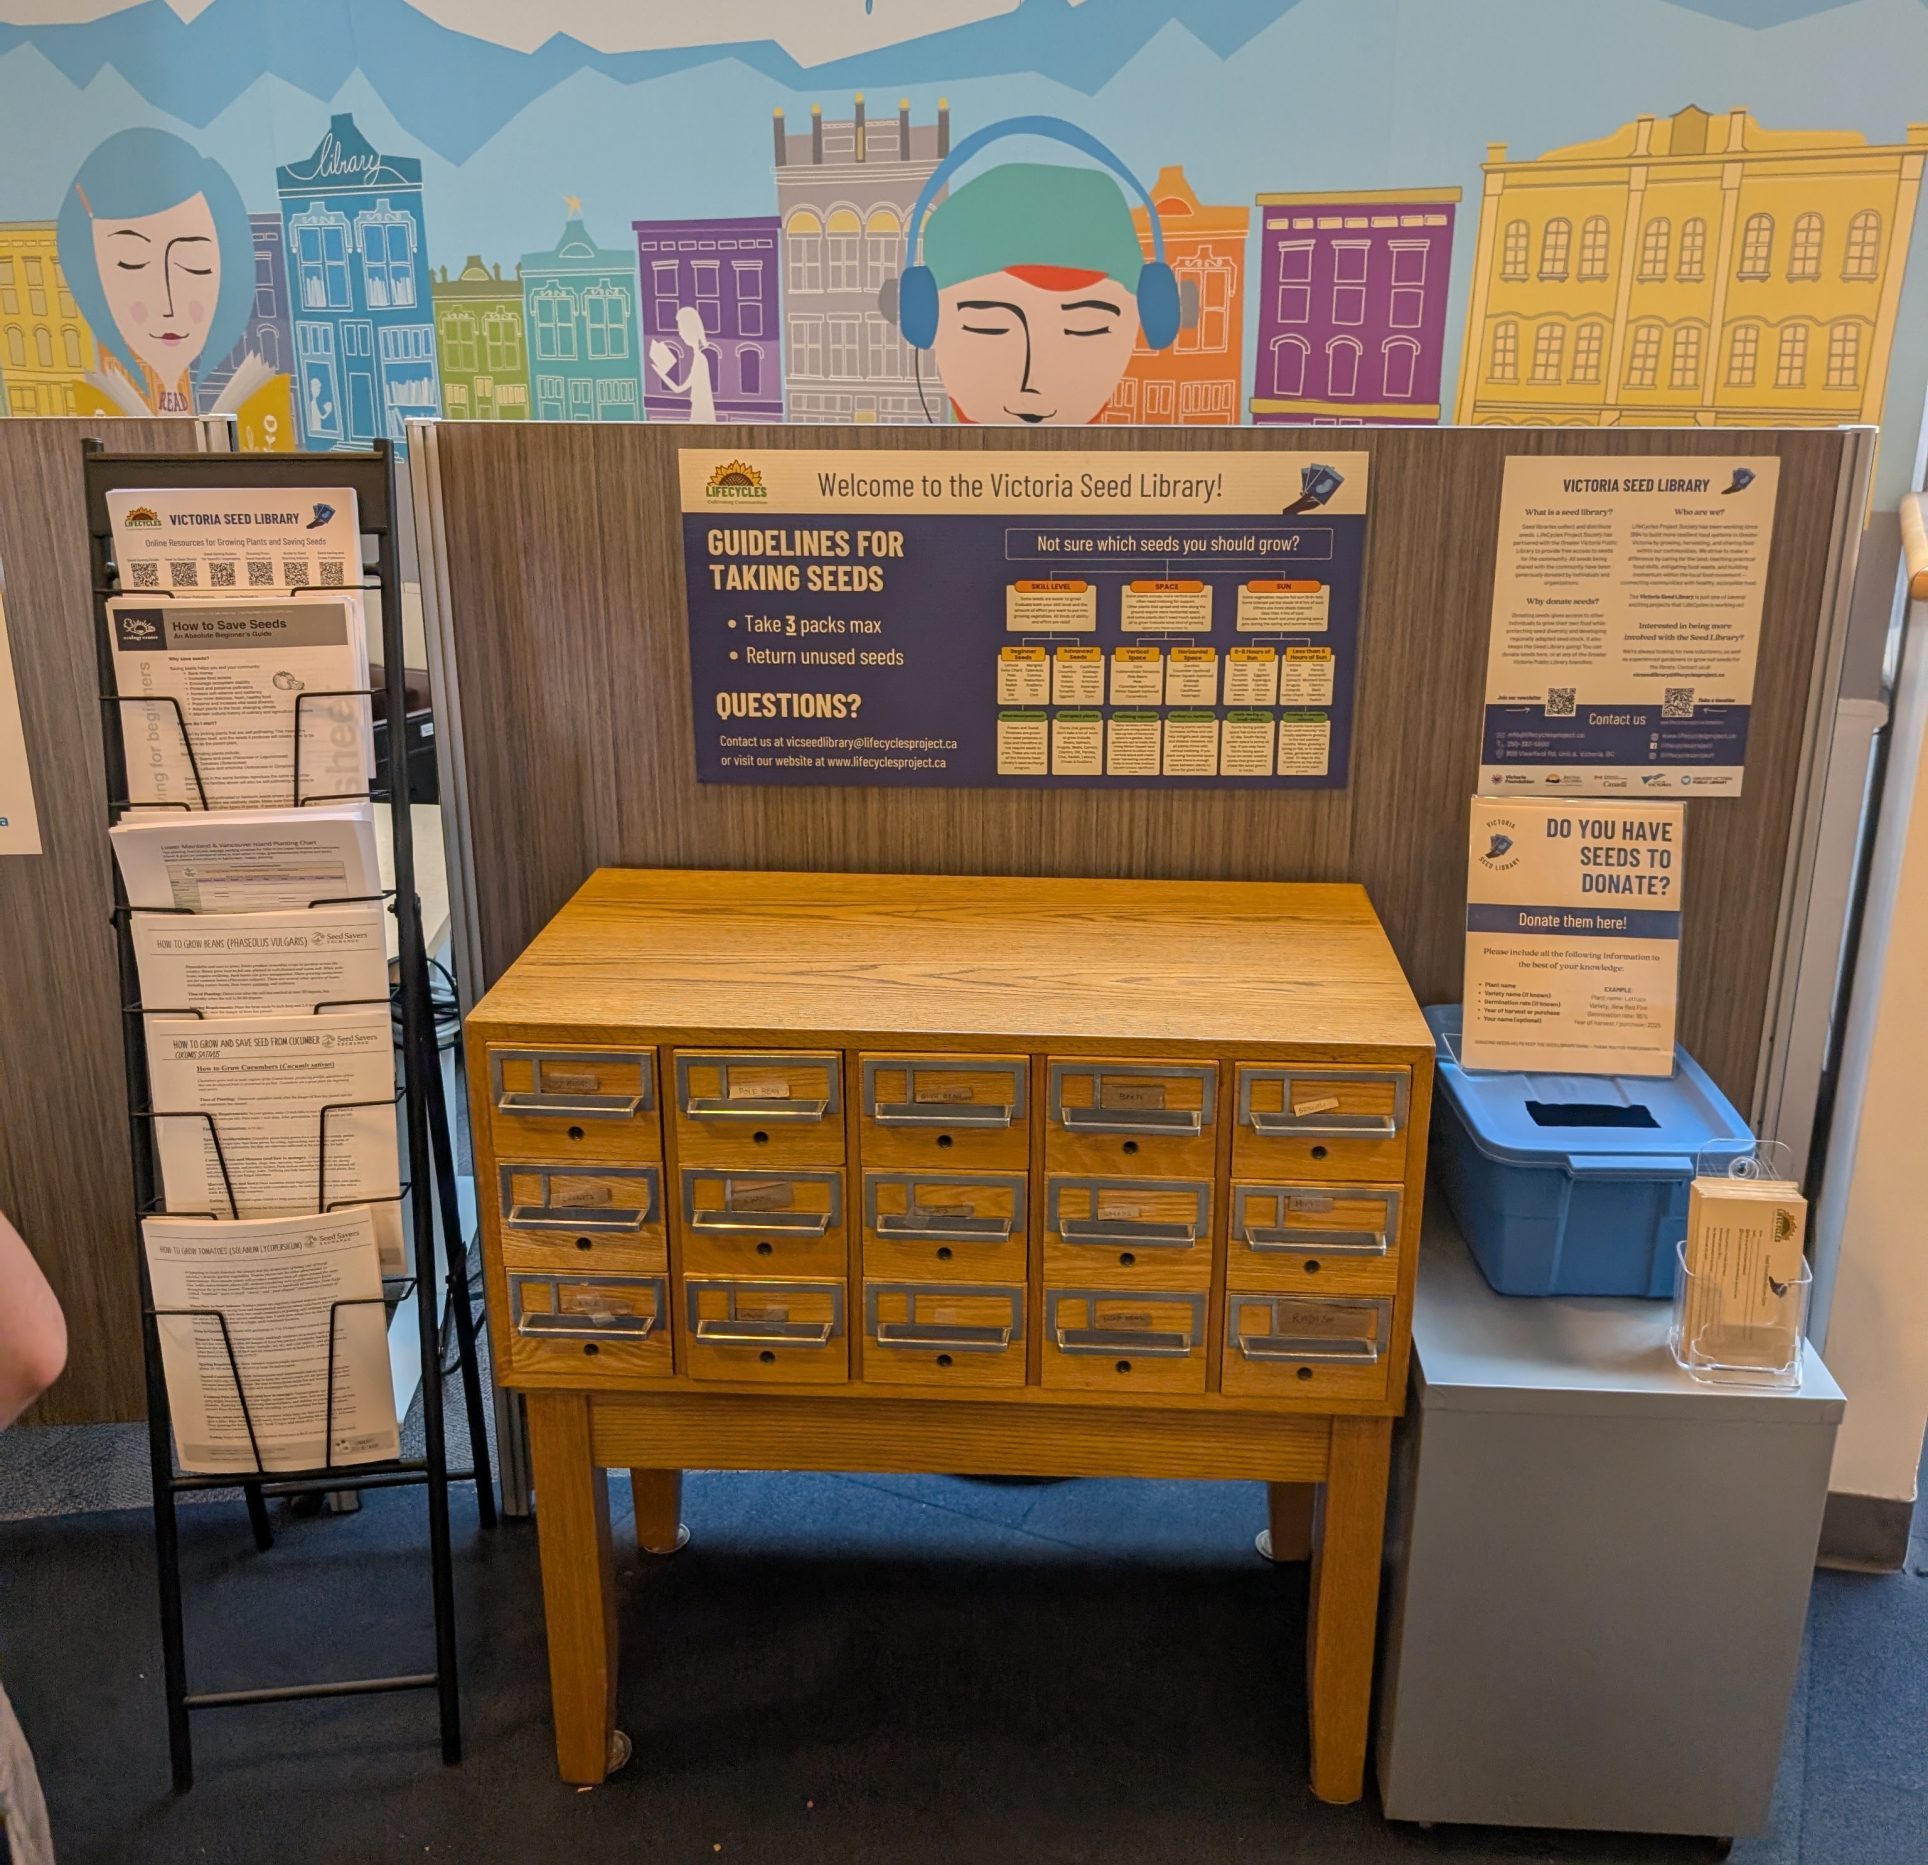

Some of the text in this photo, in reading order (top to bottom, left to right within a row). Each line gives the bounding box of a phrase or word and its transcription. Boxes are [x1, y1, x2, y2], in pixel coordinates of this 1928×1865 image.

[159, 392, 188, 412] READ
[706, 486, 767, 498] LIFECYCLES
[818, 473, 1222, 503] Welcome to the Victoria Seed Library!
[1563, 479, 1710, 492] VICTORIA SEED LIBRARY
[1525, 508, 1546, 516] What
[1581, 508, 1613, 517] library?
[1675, 508, 1693, 516] Who
[1709, 508, 1725, 516] we?
[170, 513, 299, 526] VICTORIA SEED LIBRARY
[145, 539, 167, 547] Online
[169, 539, 204, 547] Resources
[206, 538, 216, 546] for
[218, 538, 245, 547] Growing
[247, 538, 267, 546] Plants
[283, 538, 305, 547] Saving
[307, 537, 326, 545] Seeds
[708, 529, 904, 557] GUIDELINES FOR
[1038, 535, 1300, 555] Not sure which seeds you should grow?
[710, 565, 883, 592] TAKING SEEDS
[1526, 598, 1544, 606] Why
[173, 619, 286, 631] How to Save Seeds
[745, 615, 881, 636] Take 3 packs max
[1688, 622, 1710, 630] being
[1710, 634, 1744, 642] Library?
[747, 647, 904, 665] Return unused seeds
[716, 692, 861, 719] QUESTIONS?
[1589, 712, 1646, 726] Contact us
[720, 735, 957, 750] Contact us at vicseedlibrary@lifecyclesproject.ca
[721, 755, 946, 769] or visit our website at www.lifecyclesproject.ca
[1486, 819, 1515, 829] VICTORIA
[1547, 818, 1672, 842] DO YOU HAVE
[1478, 856, 1520, 871] SEED LIBRARY
[1580, 846, 1671, 869] SEEDS TO
[1582, 874, 1671, 895] DONATE?
[1519, 913, 1627, 930] Donate them here!
[157, 936, 308, 950] HOW TO GROW BEANS (PHASEOLUS VULGARIS)
[1510, 948, 1538, 956] include
[1565, 950, 1601, 960] following
[1604, 951, 1650, 960] information
[1532, 961, 1548, 969] best
[1580, 963, 1624, 972] knowledge:
[173, 1036, 320, 1049] HOW TO GROW AND SAVE SEED FROM CUCUMBER
